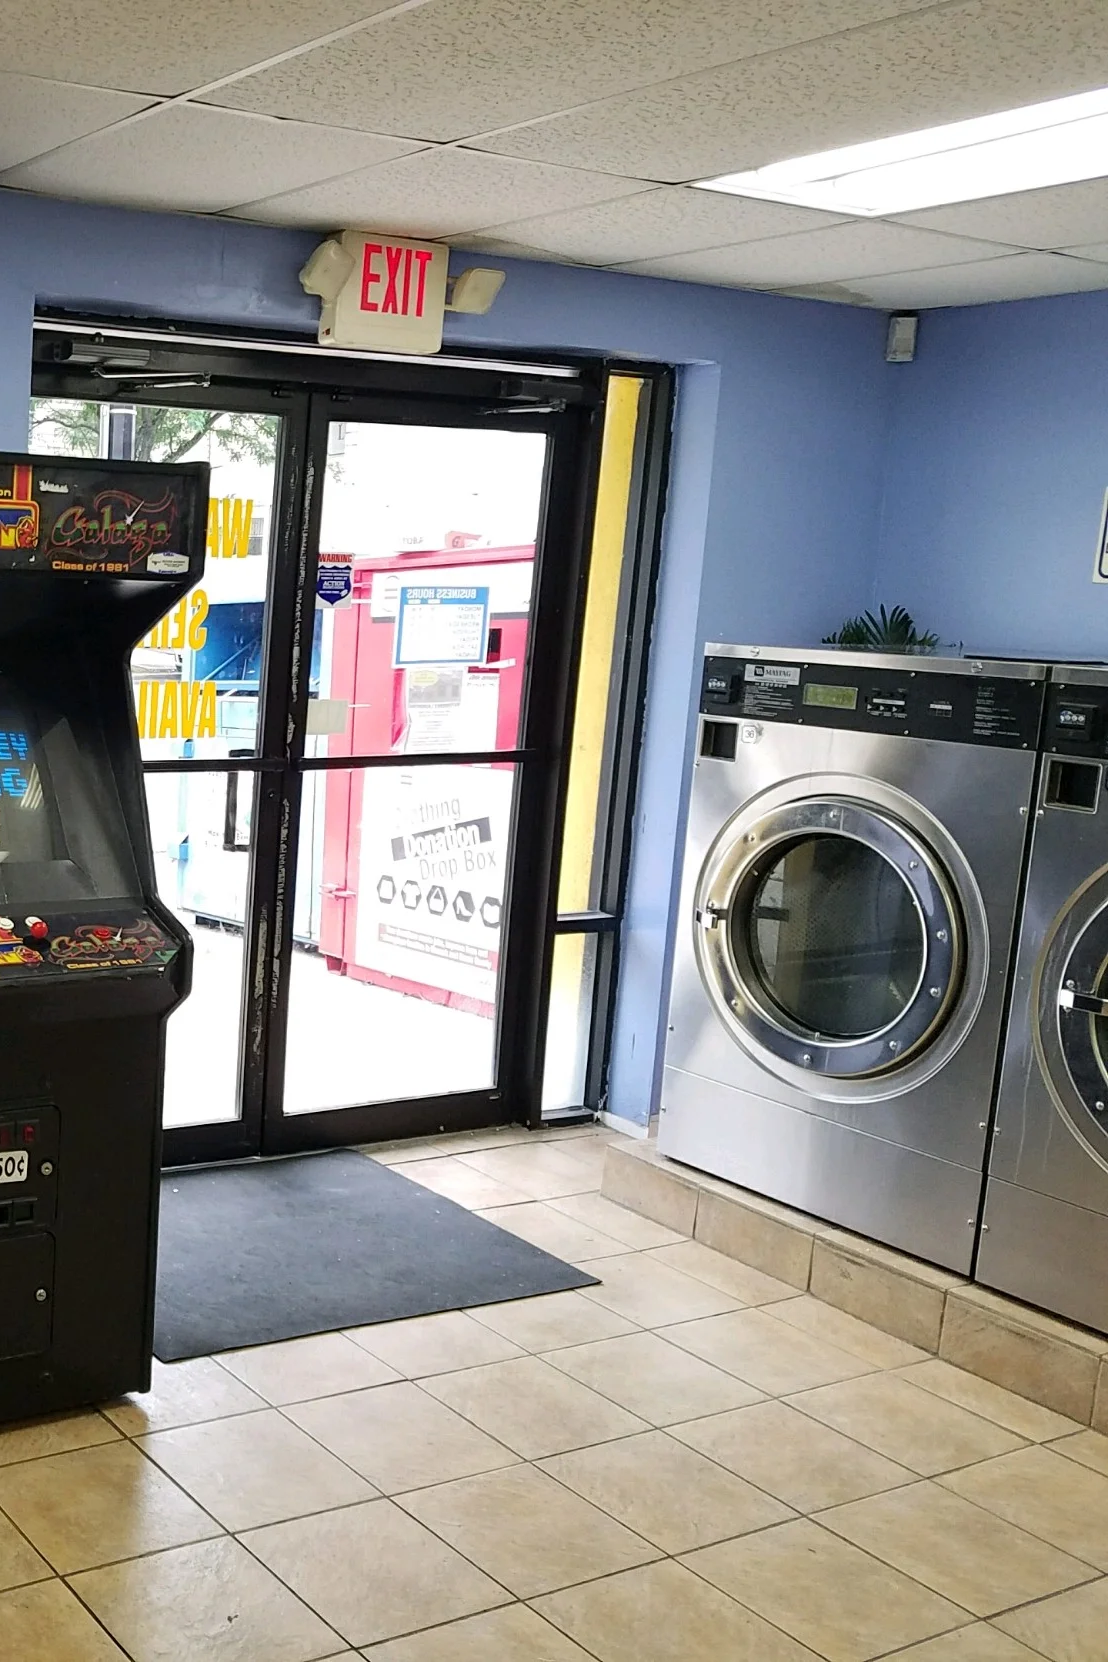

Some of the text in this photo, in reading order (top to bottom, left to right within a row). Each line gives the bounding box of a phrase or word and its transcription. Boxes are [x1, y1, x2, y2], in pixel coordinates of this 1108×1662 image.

[360, 243, 432, 317] EXIT
[316, 553, 352, 562] WARNING
[52, 561, 129, 573] Class of 1981
[765, 668, 791, 677] MAYTAG
[745, 729, 754, 738] 36
[403, 824, 481, 860] Donation
[420, 849, 496, 880] Drop Box
